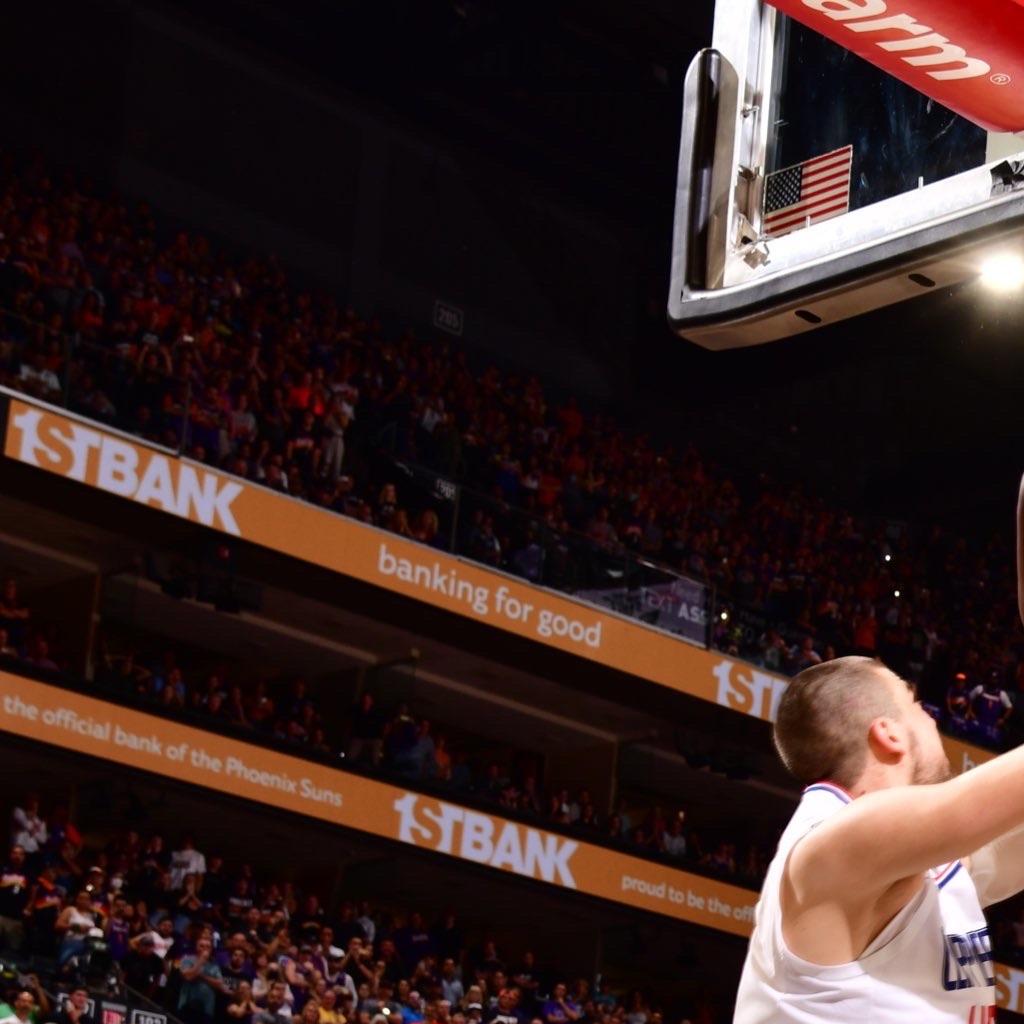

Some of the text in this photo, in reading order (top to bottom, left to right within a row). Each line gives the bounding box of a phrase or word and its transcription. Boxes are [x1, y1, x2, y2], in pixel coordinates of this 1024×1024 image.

[14, 409, 244, 537] 1STBANK
[378, 544, 602, 648] banking for good
[4, 695, 343, 807] the official bank of the Phoenix Suns
[394, 793, 579, 889] 1STBANK
[621, 872, 665, 899] proud
[668, 885, 684, 905] to
[687, 888, 705, 910] be
[707, 894, 732, 919] the
